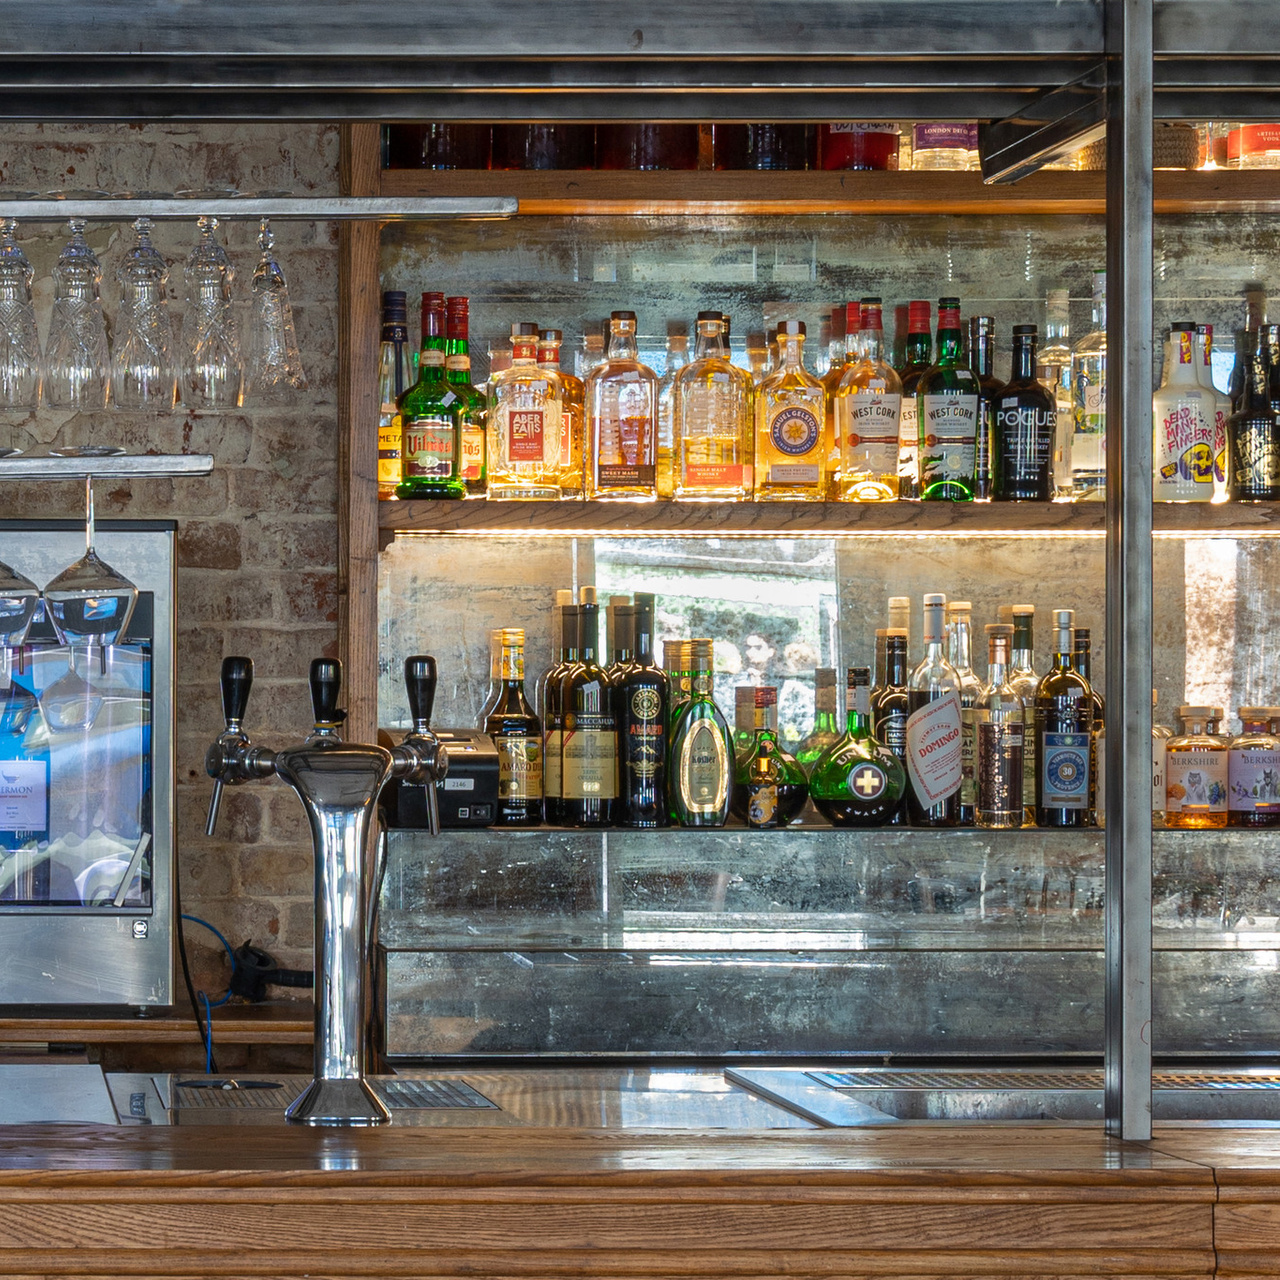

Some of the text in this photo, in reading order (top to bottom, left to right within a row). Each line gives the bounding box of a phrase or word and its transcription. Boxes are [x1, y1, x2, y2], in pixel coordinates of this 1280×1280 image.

[513, 413, 541, 424] ABER
[851, 407, 896, 420] WEST CORK
[901, 410, 917, 422] EST
[928, 407, 951, 421] WEST
[953, 407, 974, 421] CORK
[996, 410, 1057, 427] POGUES
[1164, 407, 1191, 431] DEAD
[774, 411, 792, 438] SAMUEL
[1168, 428, 1213, 454] FINGERS
[630, 724, 662, 735] AMARO
[918, 728, 960, 758] DOMINGO
[691, 755, 716, 764] Kosher
[1172, 757, 1219, 766] BERKSHIRE
[501, 762, 531, 772] AMARO
[1062, 767, 1073, 776] 30
[845, 805, 885, 817] ZWACK
